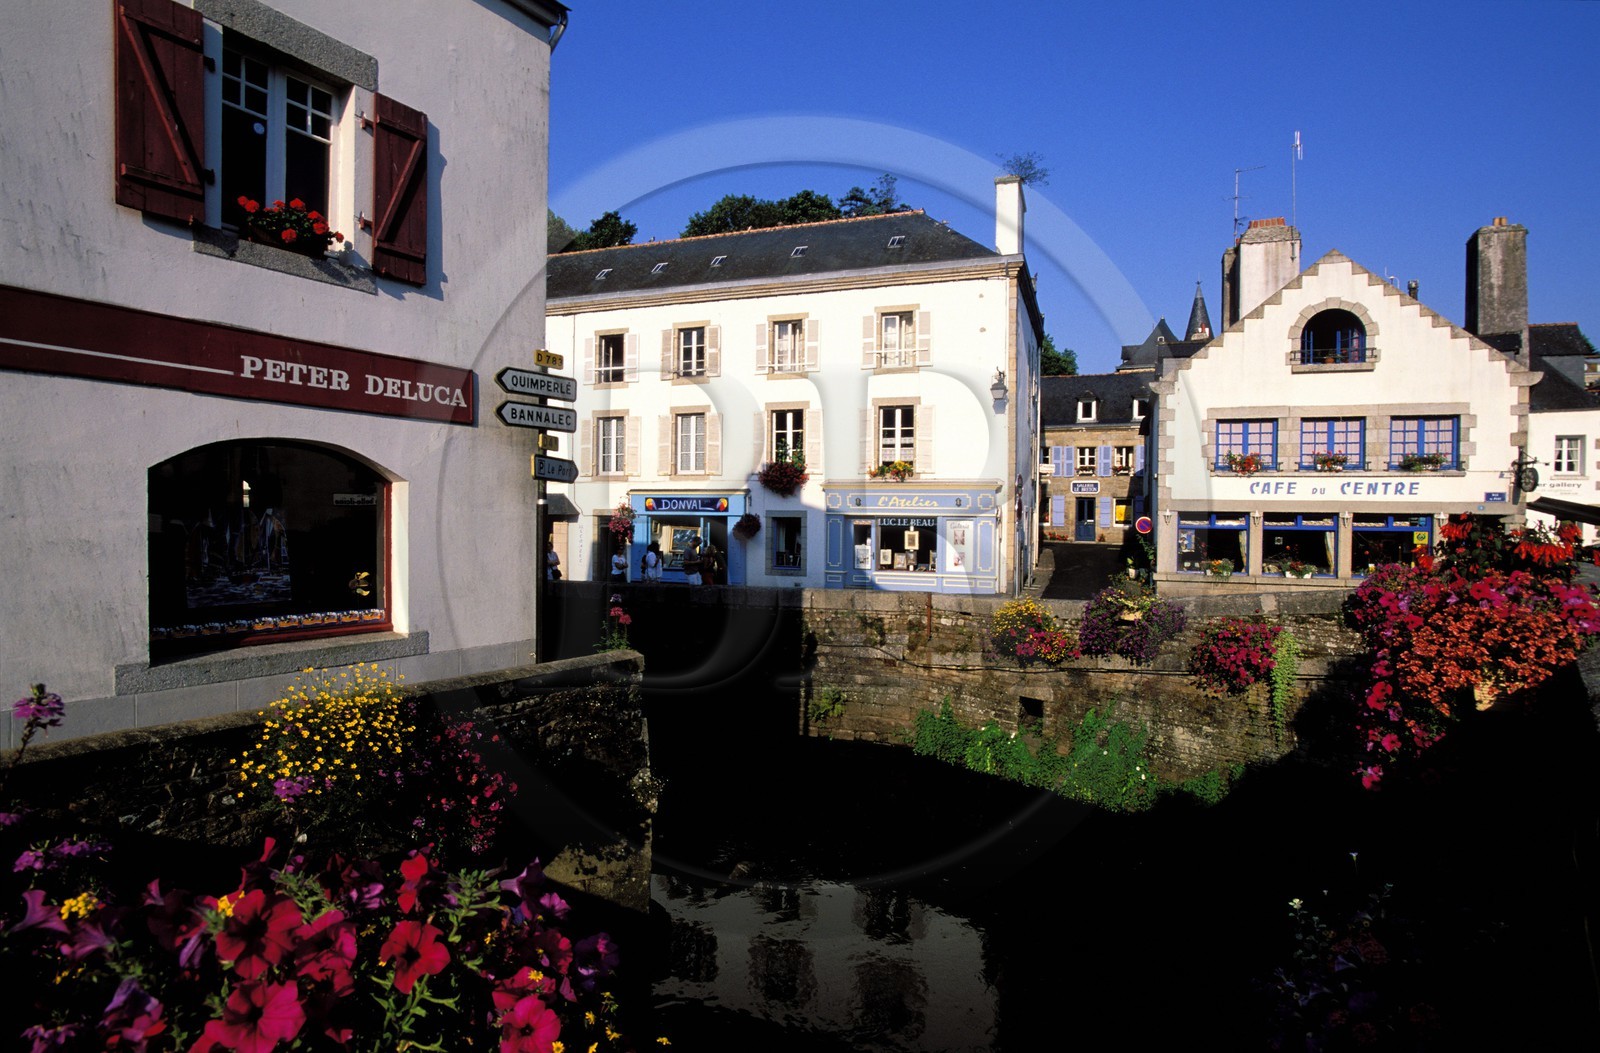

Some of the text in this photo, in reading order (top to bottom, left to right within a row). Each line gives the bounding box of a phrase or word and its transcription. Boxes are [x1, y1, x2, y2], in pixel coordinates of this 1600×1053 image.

[536, 353, 543, 362] D
[240, 355, 468, 408] PETER DELUCA
[511, 375, 572, 395] QUIMPERLÉ
[511, 408, 572, 426] BANNALEC
[547, 463, 555, 474] Le
[1249, 481, 1421, 495] CAFE DU CENTRE
[658, 499, 712, 511] DONVAL
[877, 495, 939, 508] l'Atelier
[877, 518, 935, 527] LUC LE BEAU
